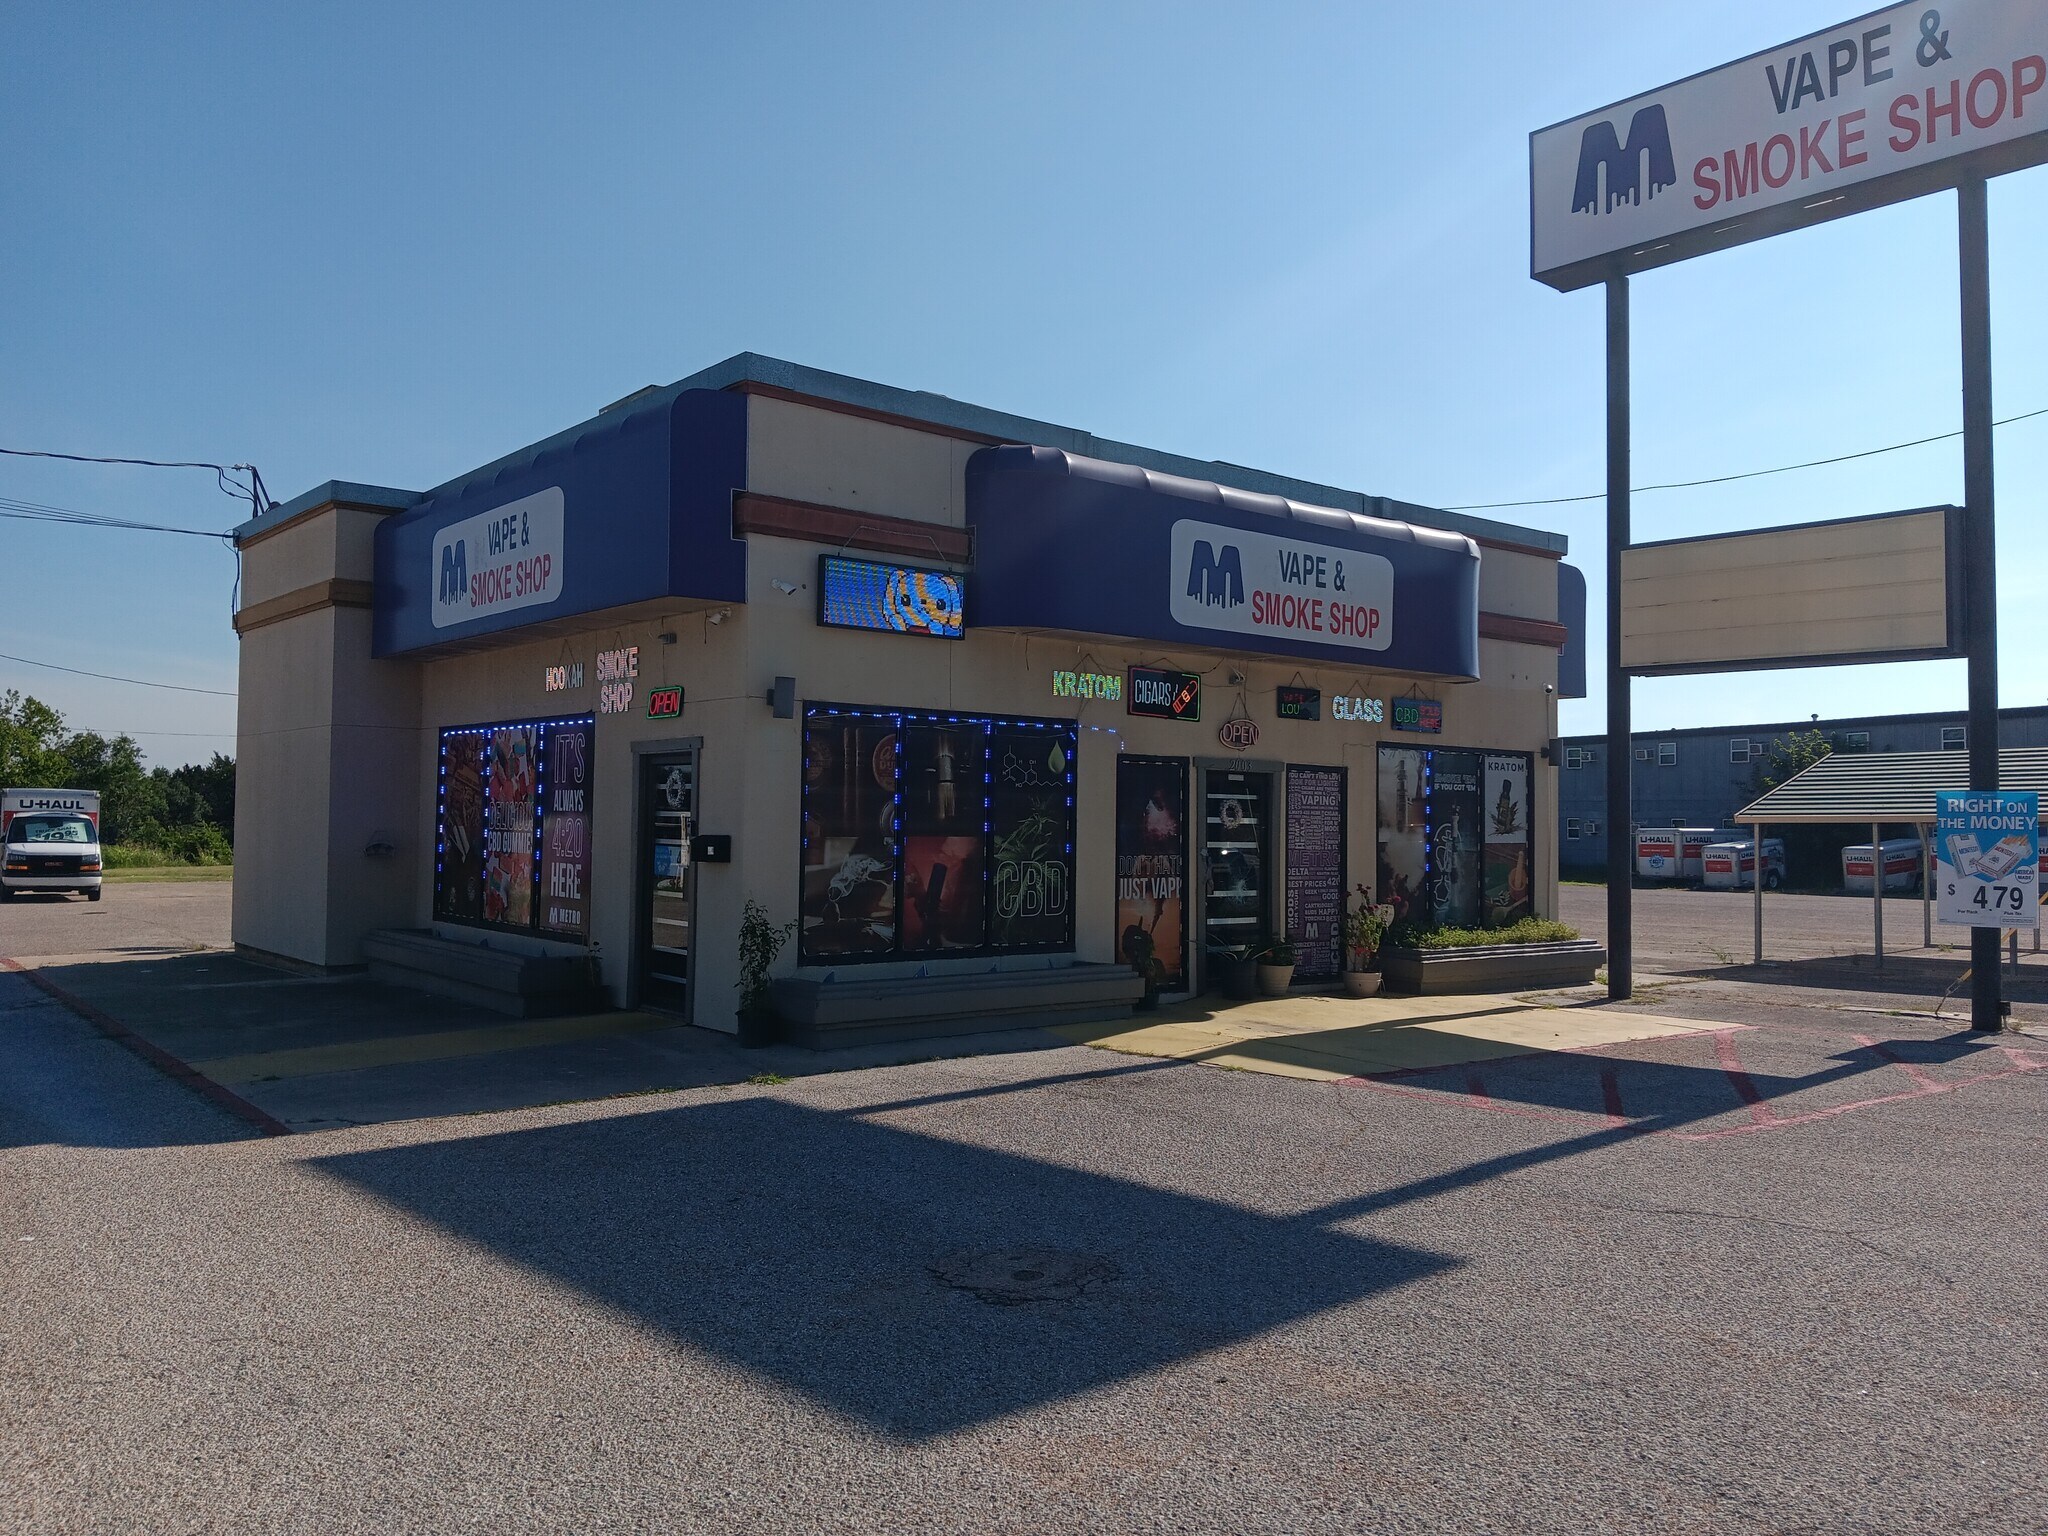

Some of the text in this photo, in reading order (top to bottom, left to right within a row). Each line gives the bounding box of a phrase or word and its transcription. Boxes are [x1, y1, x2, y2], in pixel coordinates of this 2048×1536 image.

[1765, 9, 1952, 114] VAPE &
[1693, 55, 2048, 210] SMOKE SHOP
[488, 512, 530, 556] VAPE &
[471, 553, 551, 607] SMOKE SHOP
[1279, 549, 1346, 591] VAPE &
[1252, 590, 1379, 638] SMOKE SHOP
[545, 663, 584, 692] HOOKAH
[596, 646, 639, 681] SMOKE
[600, 682, 633, 713] SHOP
[1052, 670, 1122, 701] KRATOM
[1134, 679, 1171, 707] CIGARS
[650, 691, 680, 715] OPEN
[1332, 695, 1385, 724] GLASS
[1395, 707, 1419, 724] CBD
[1223, 723, 1258, 747] OPEN
[553, 732, 585, 784] IT'S
[1488, 762, 1524, 772] KRATOM
[19, 799, 85, 810] U-HAUL
[552, 789, 584, 812] ALWAYS
[1301, 795, 1336, 806] VAPING
[1947, 798, 2028, 813] RIGHT ON
[1938, 816, 2036, 830] THE MONEY
[487, 831, 502, 852] CBD
[551, 818, 583, 858] 4:20
[1685, 836, 1714, 844] U-HAUL
[1118, 855, 1152, 876] DON'T
[1886, 853, 1907, 861] U-HAUL
[550, 862, 582, 900] HERE
[996, 861, 1067, 918] CBD
[1118, 877, 1148, 900] JUST
[1947, 883, 2023, 911] $ 4.79
[559, 908, 581, 925] METRO
